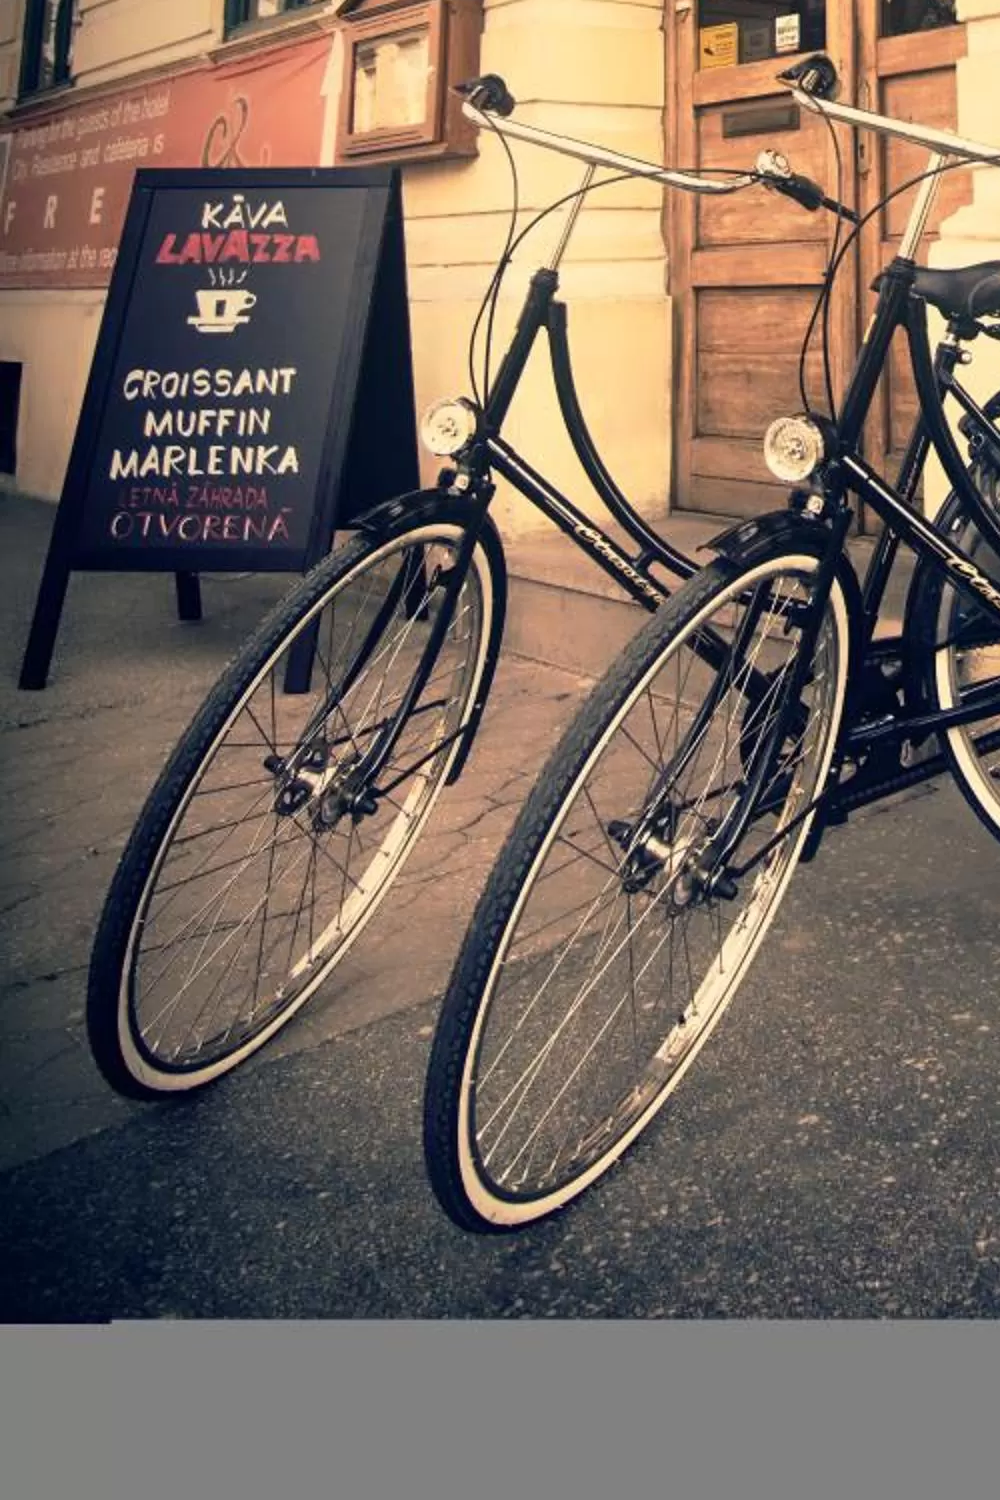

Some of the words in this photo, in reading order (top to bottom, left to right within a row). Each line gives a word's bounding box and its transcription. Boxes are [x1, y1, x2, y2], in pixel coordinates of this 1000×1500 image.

[155, 229, 321, 265] LAVAZZA
[123, 366, 297, 400] CROISSANT
[143, 408, 271, 438] MUFFIN
[109, 444, 299, 480] MARLENKA
